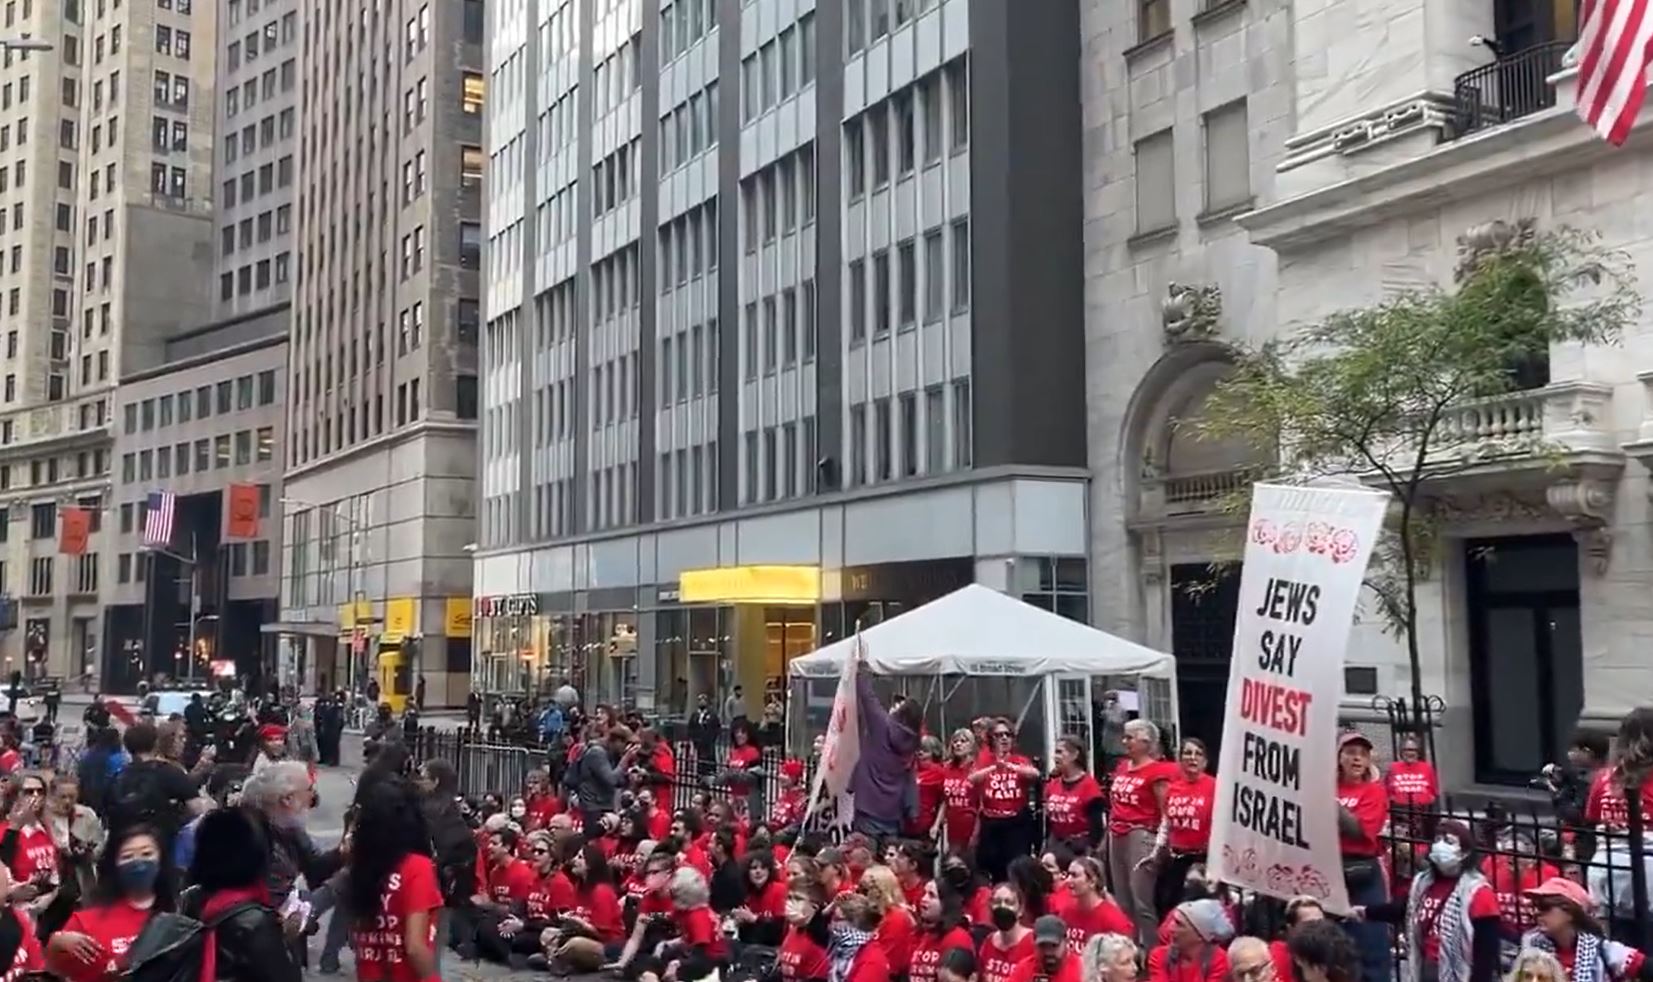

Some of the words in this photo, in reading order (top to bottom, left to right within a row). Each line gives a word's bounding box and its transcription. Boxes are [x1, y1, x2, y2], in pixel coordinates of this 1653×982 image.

[508, 592, 539, 614] GIFTS
[1257, 578, 1321, 625] JEWS
[1259, 630, 1302, 677] SAY
[1240, 677, 1312, 736] DIVEST
[1243, 731, 1300, 791] FROM
[990, 780, 1017, 790] OUR
[1168, 806, 1196, 817] OUR
[1232, 782, 1310, 850] ISRAEL
